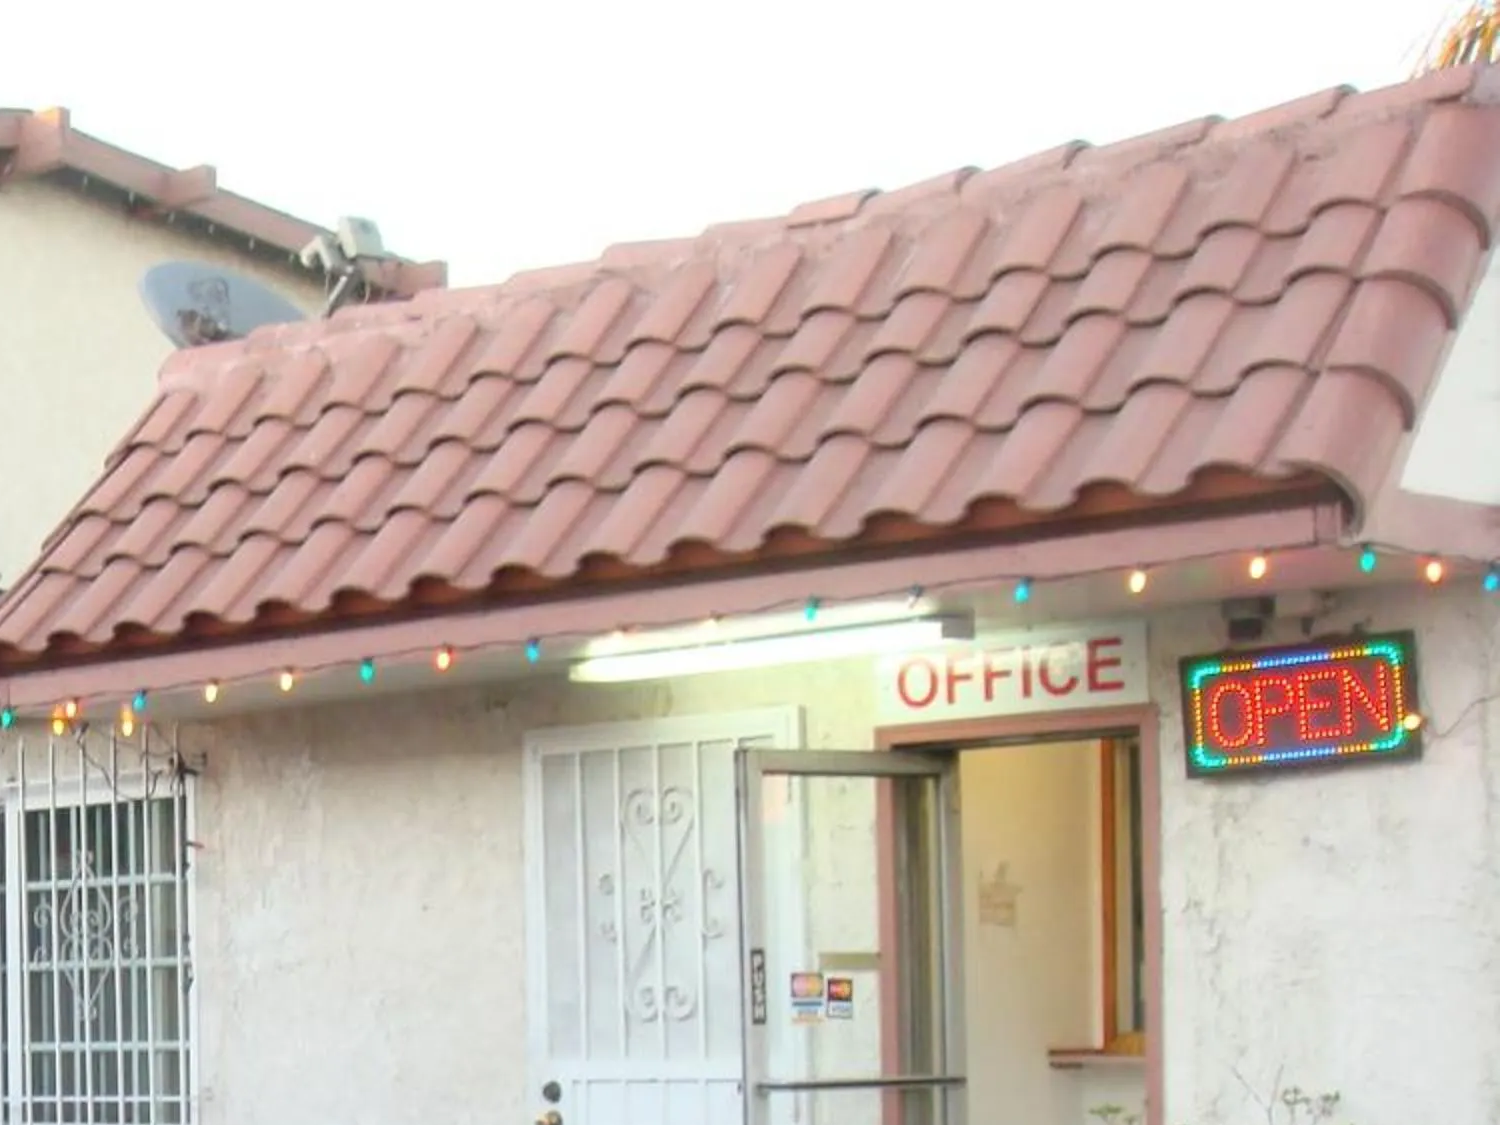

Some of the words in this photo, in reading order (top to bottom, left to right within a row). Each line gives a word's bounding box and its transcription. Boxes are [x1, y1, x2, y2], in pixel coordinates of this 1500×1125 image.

[897, 637, 1126, 709] OFFICE
[1208, 664, 1391, 748] OPEN
[752, 952, 765, 1021] PUSH
